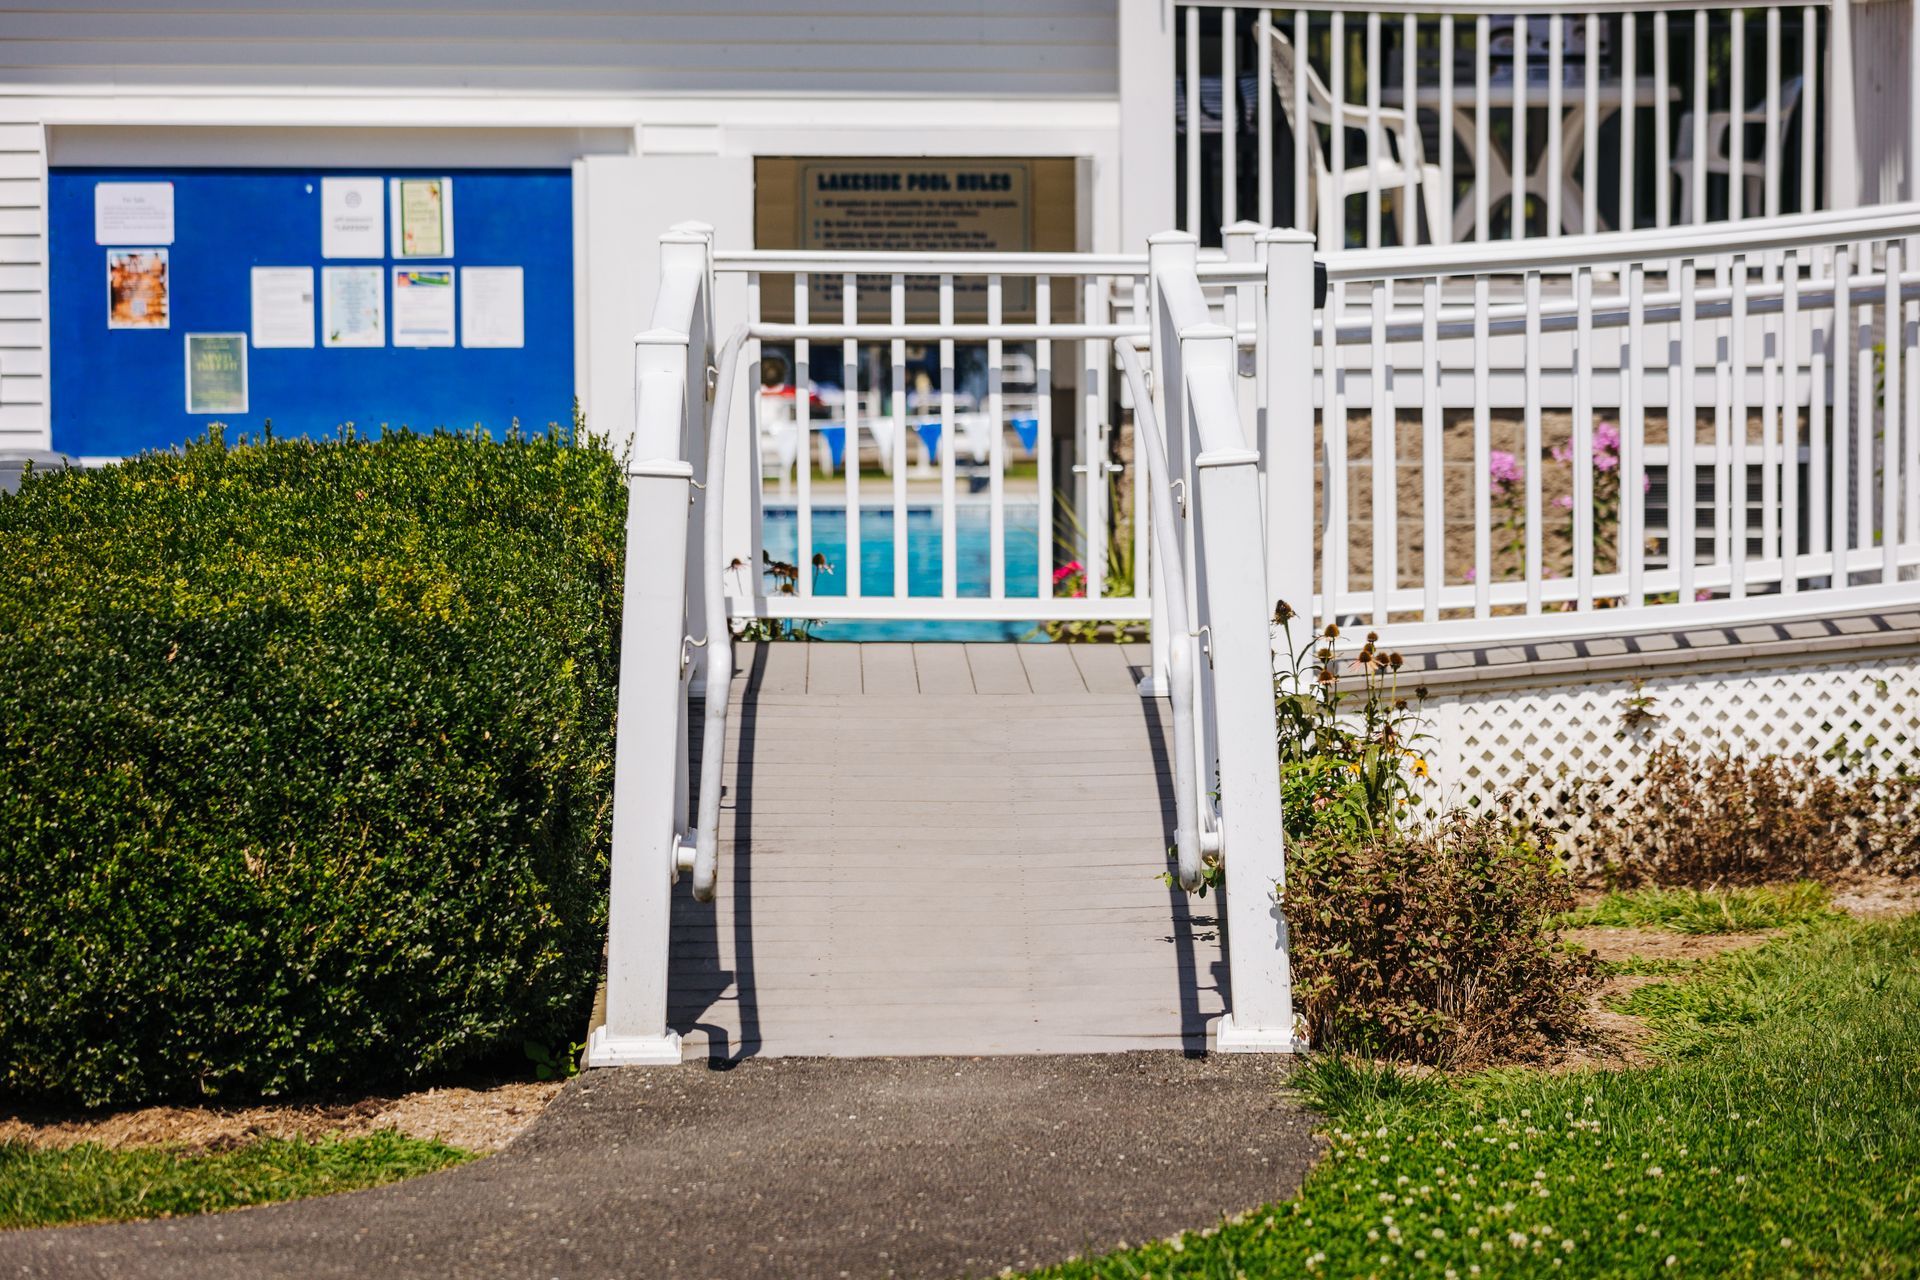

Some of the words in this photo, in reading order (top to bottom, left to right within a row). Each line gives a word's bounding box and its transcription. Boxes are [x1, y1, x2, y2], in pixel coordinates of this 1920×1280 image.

[818, 173, 901, 191] LAKESIDE
[907, 173, 951, 191] POOL
[957, 173, 1012, 191] RULES
